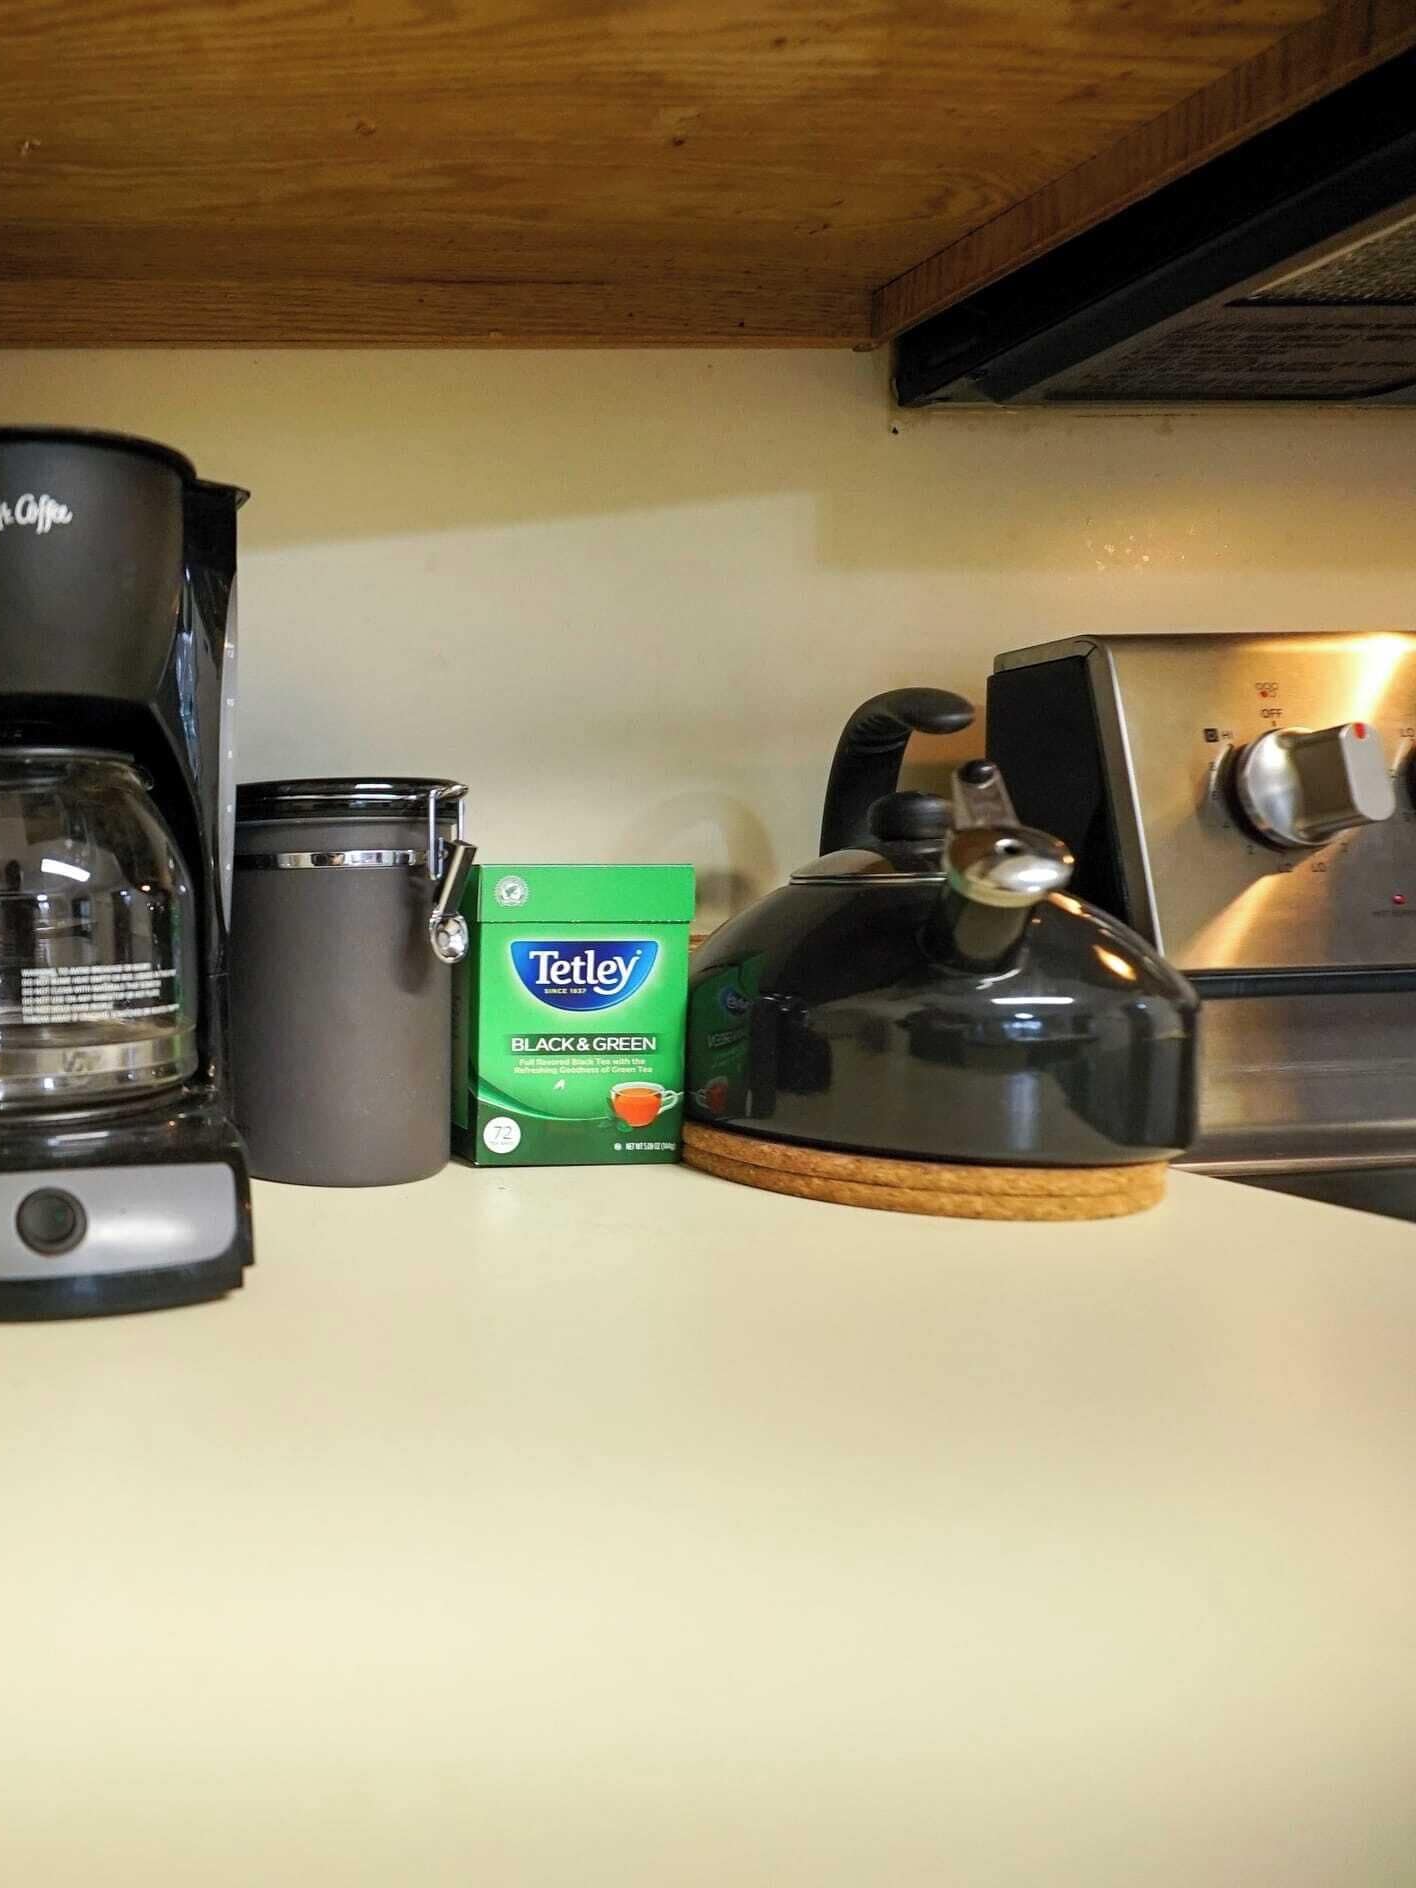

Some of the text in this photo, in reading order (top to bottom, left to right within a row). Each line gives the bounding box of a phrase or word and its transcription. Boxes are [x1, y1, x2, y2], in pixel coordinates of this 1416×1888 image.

[14, 493, 73, 535] Coffee
[1261, 707, 1284, 720] OFF
[528, 948, 643, 996] Tetley
[511, 1036, 657, 1052] BLACK & GREEN
[595, 1057, 611, 1066] Tea
[612, 1057, 631, 1065] with
[632, 1057, 646, 1065] the
[637, 1065, 653, 1073] Tea
[492, 1126, 513, 1140] 72
